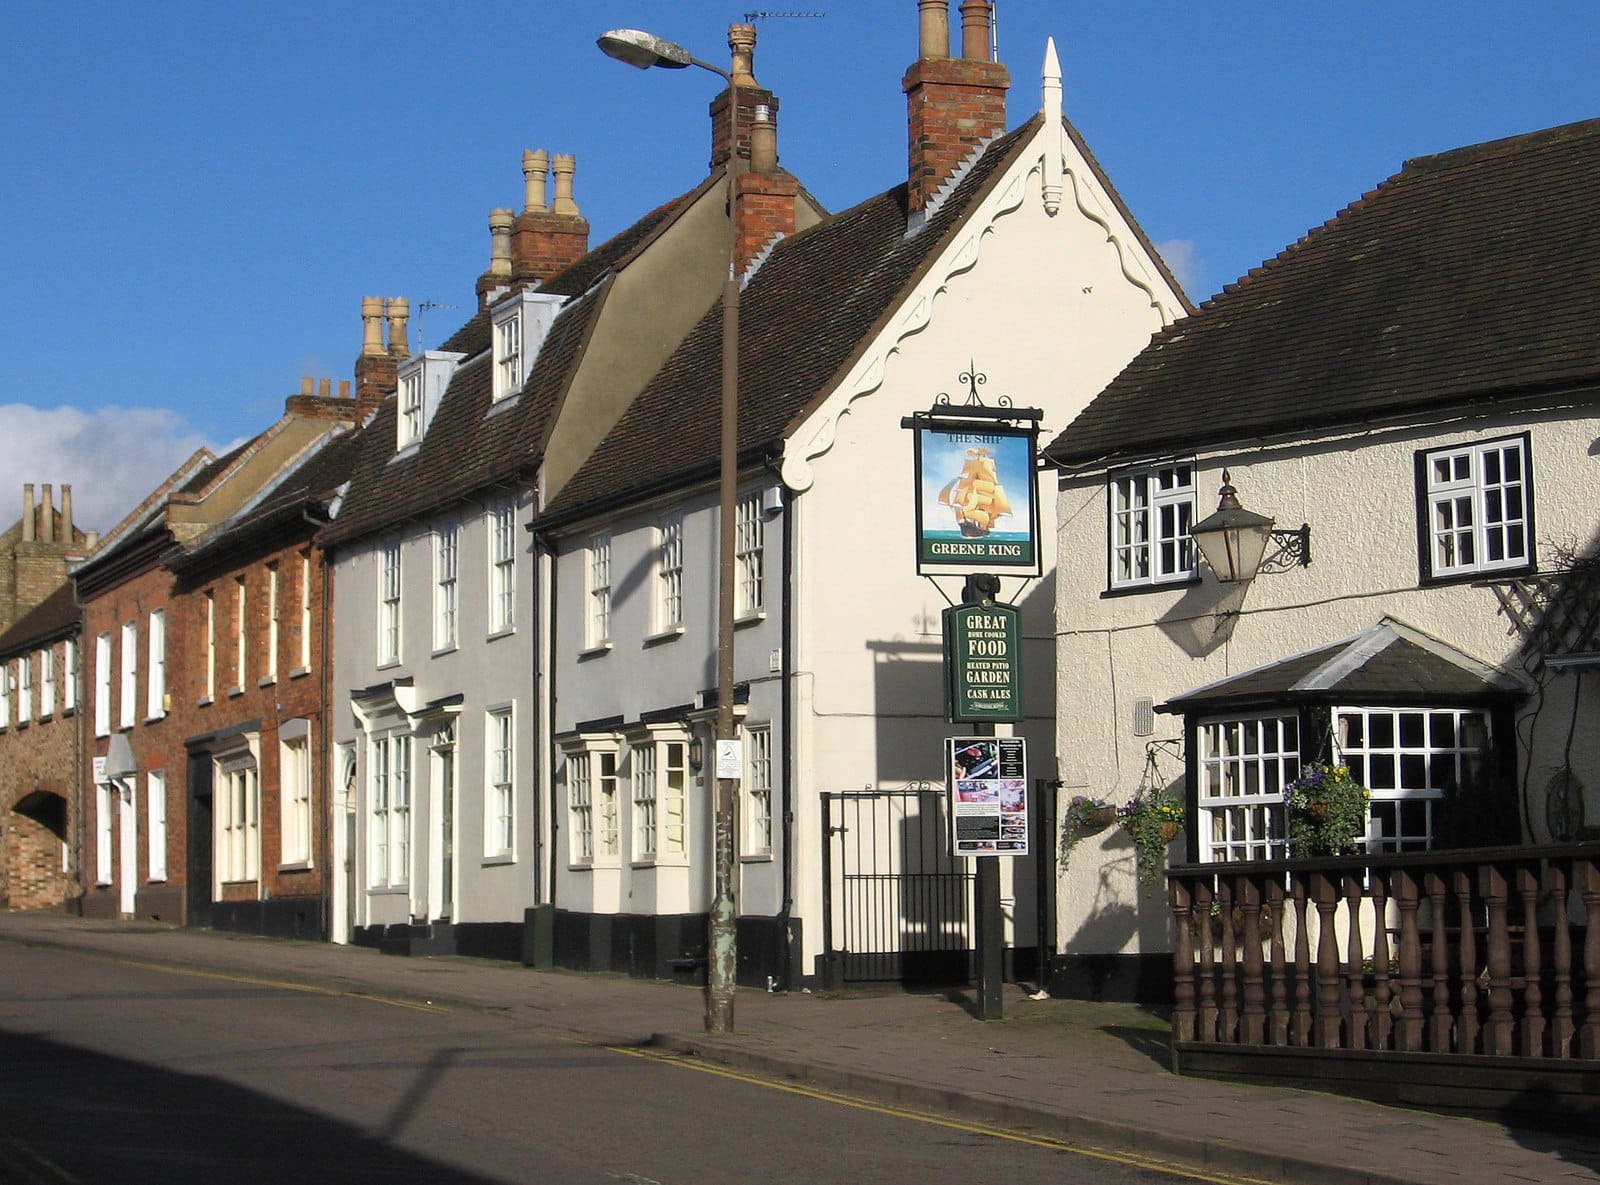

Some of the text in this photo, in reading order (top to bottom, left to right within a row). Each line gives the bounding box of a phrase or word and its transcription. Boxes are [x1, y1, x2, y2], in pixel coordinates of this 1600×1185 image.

[948, 433, 1004, 444] THE SHIP
[931, 543, 1021, 556] GREENE KING
[966, 615, 1007, 629] GREAT
[968, 640, 1007, 656] FOOD
[992, 662, 1010, 670] PATIO
[966, 671, 1010, 683] GARDEN
[967, 689, 1011, 699] CASK ALES
